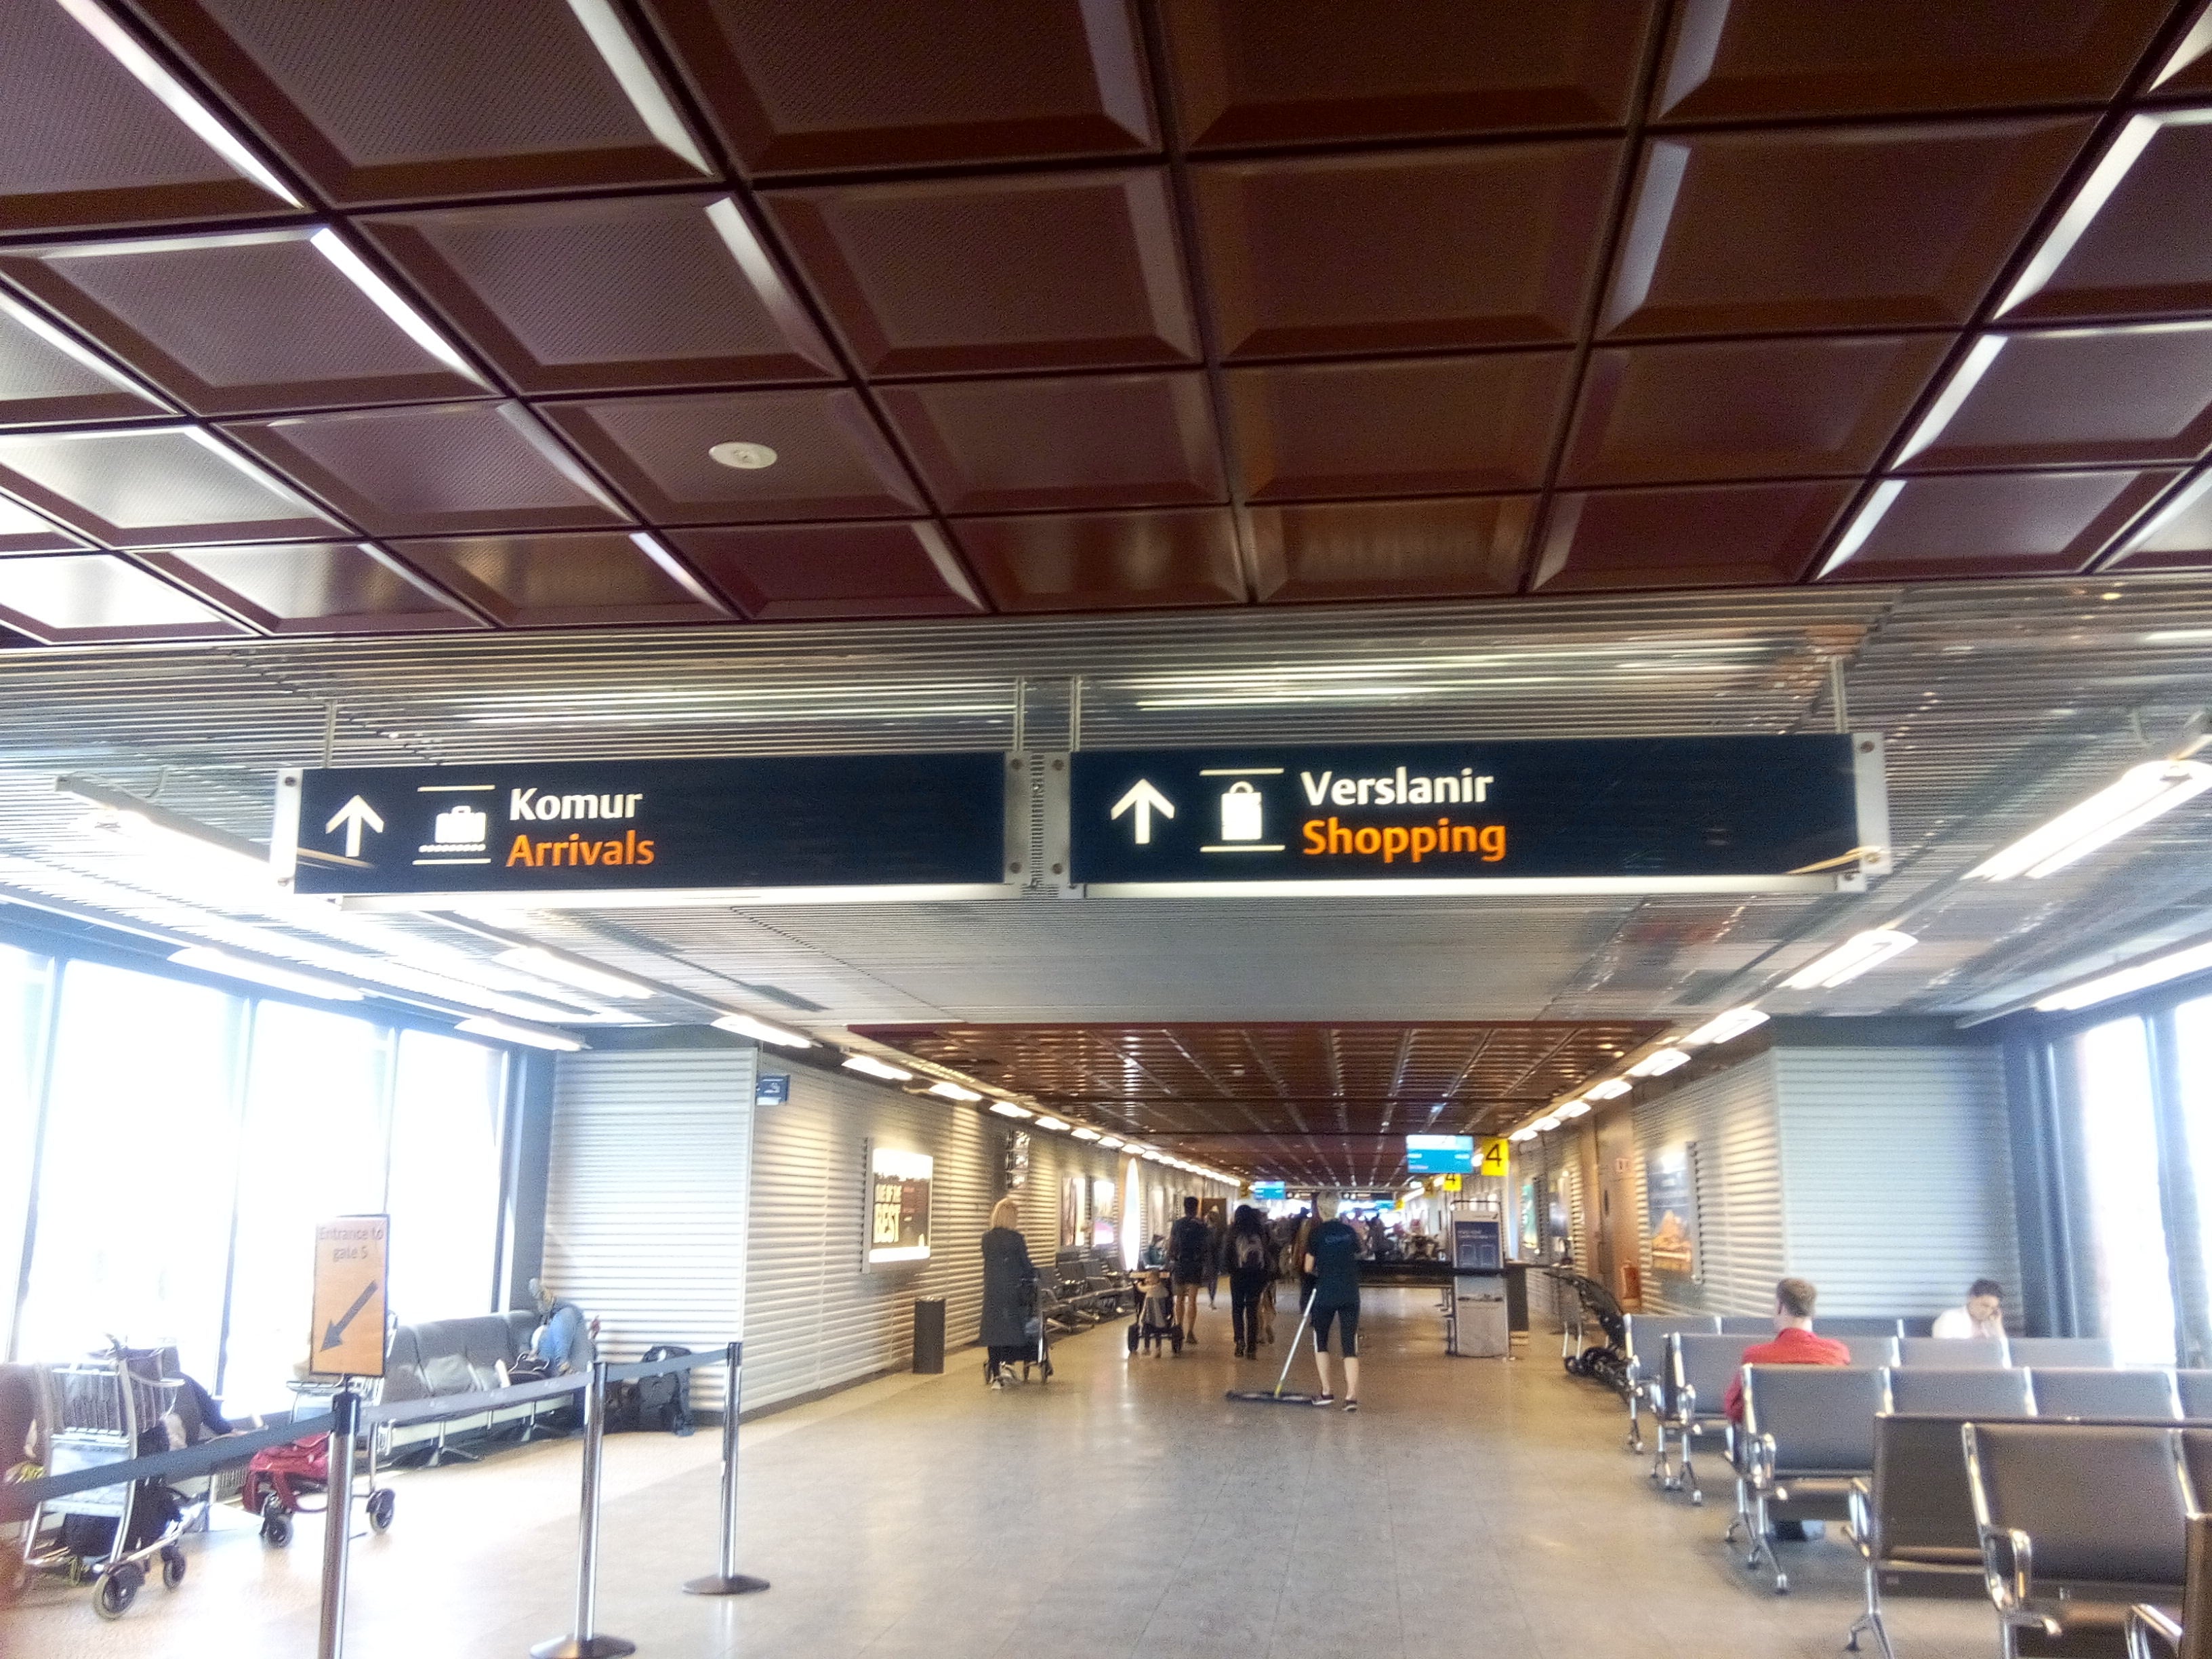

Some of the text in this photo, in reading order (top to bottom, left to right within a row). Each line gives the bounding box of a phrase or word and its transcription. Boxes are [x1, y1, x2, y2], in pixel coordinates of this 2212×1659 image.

[1300, 766, 1494, 806] Verslanir
[510, 787, 643, 821] Komur
[506, 830, 655, 867] Arrivals
[1302, 817, 1507, 863] Shopping
[1486, 1143, 1502, 1167] 4
[1446, 1173, 1456, 1185] 4
[320, 1227, 384, 1240] Entrance to
[333, 1246, 369, 1262] gate 5
